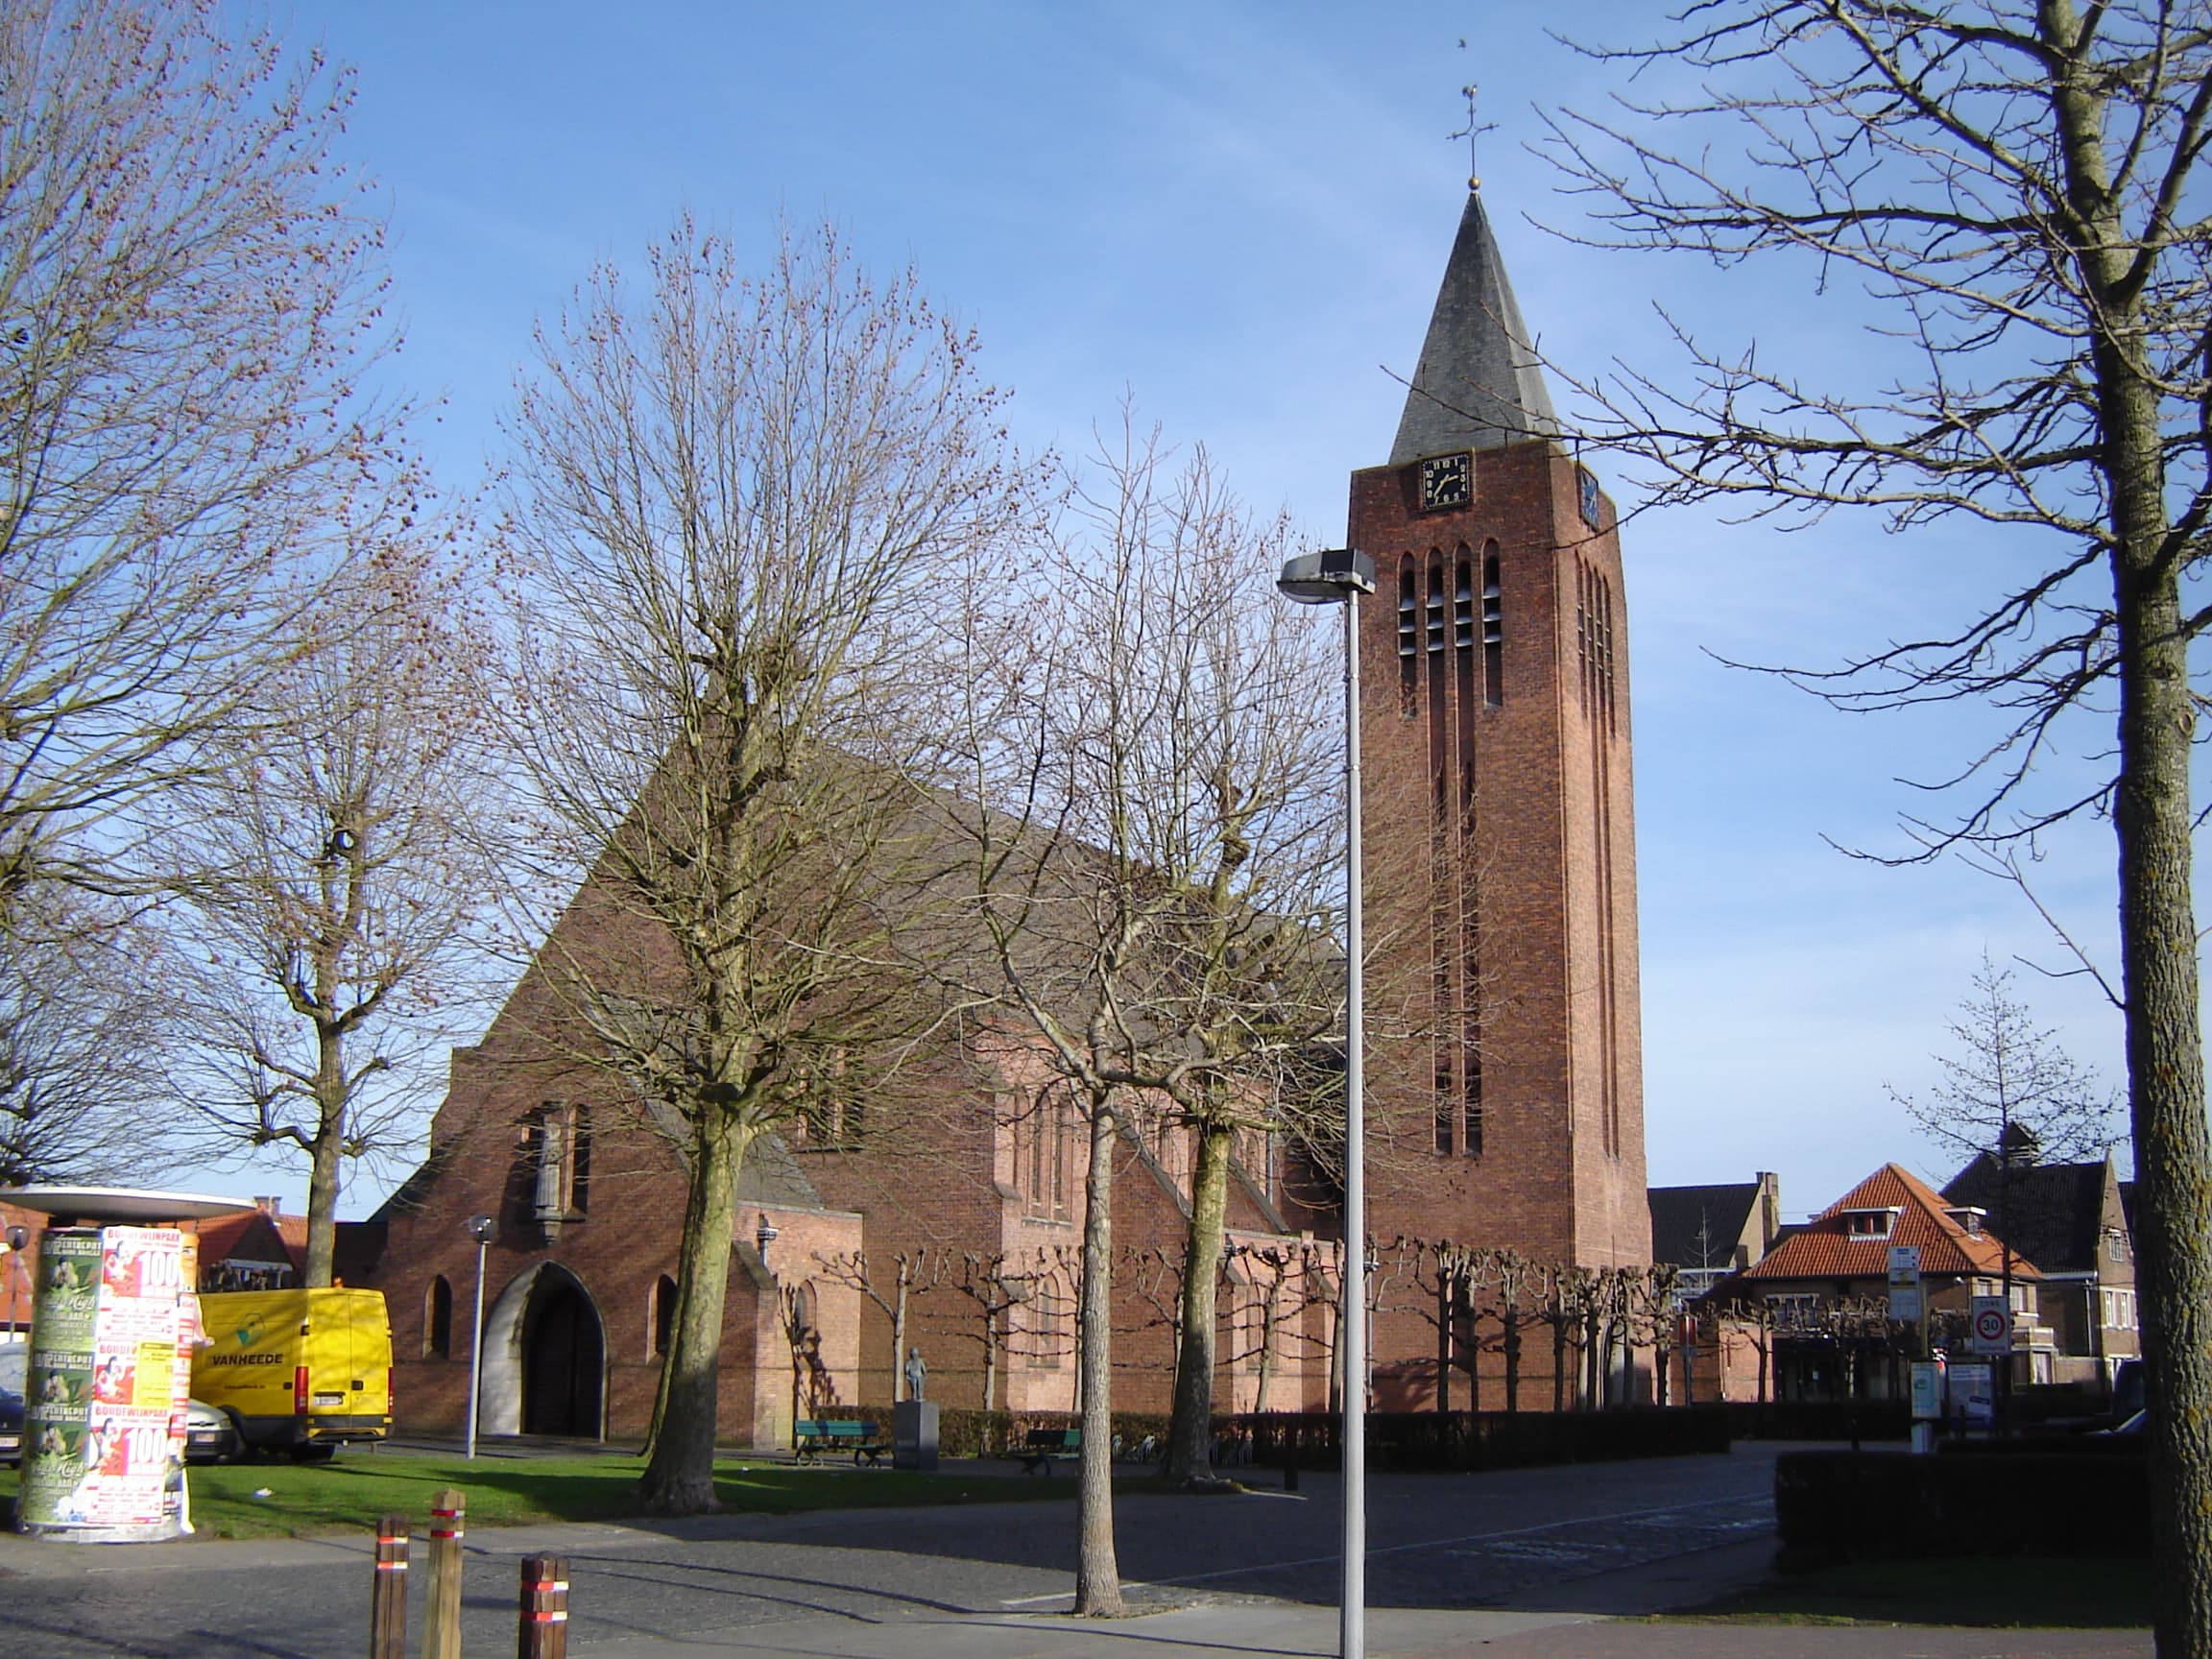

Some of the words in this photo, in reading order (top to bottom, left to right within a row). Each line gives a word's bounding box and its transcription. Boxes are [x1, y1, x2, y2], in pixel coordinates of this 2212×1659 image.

[108, 1229, 180, 1242] BODEWIJNPARK
[138, 1251, 180, 1286] 100
[1983, 1319, 2000, 1332] 30
[213, 1354, 284, 1366] VANHEEDE
[126, 1429, 167, 1463] 100
